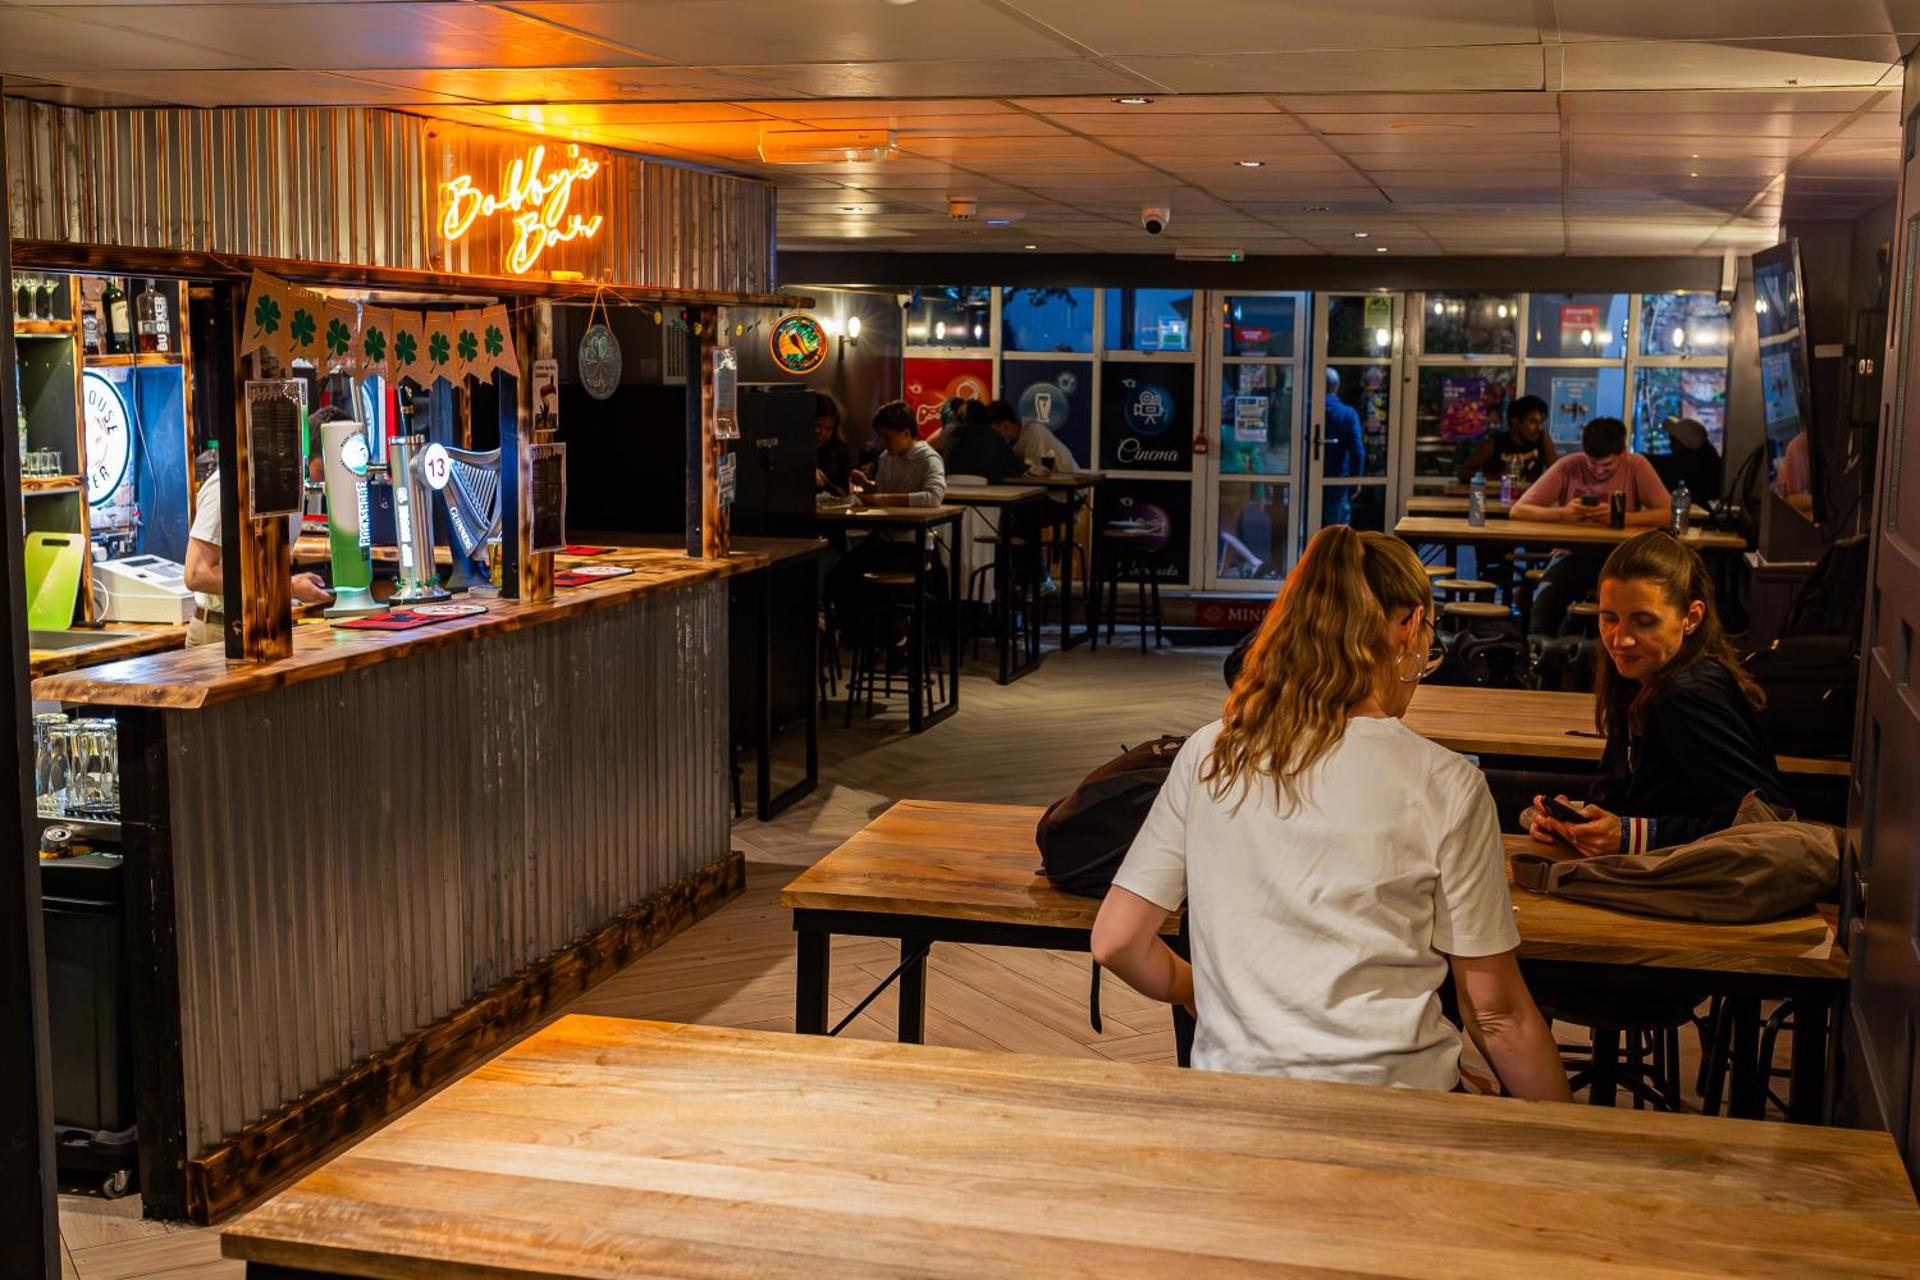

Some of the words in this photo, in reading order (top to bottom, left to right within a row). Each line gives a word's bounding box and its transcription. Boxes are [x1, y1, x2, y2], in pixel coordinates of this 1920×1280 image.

[444, 144, 599, 240] Bobby's
[512, 211, 602, 274] Bar
[154, 296, 169, 351] BUSKER
[88, 389, 119, 436] OUSE
[428, 458, 445, 477] 13
[1117, 437, 1178, 463] Cinema
[450, 506, 473, 550] GUINNESS
